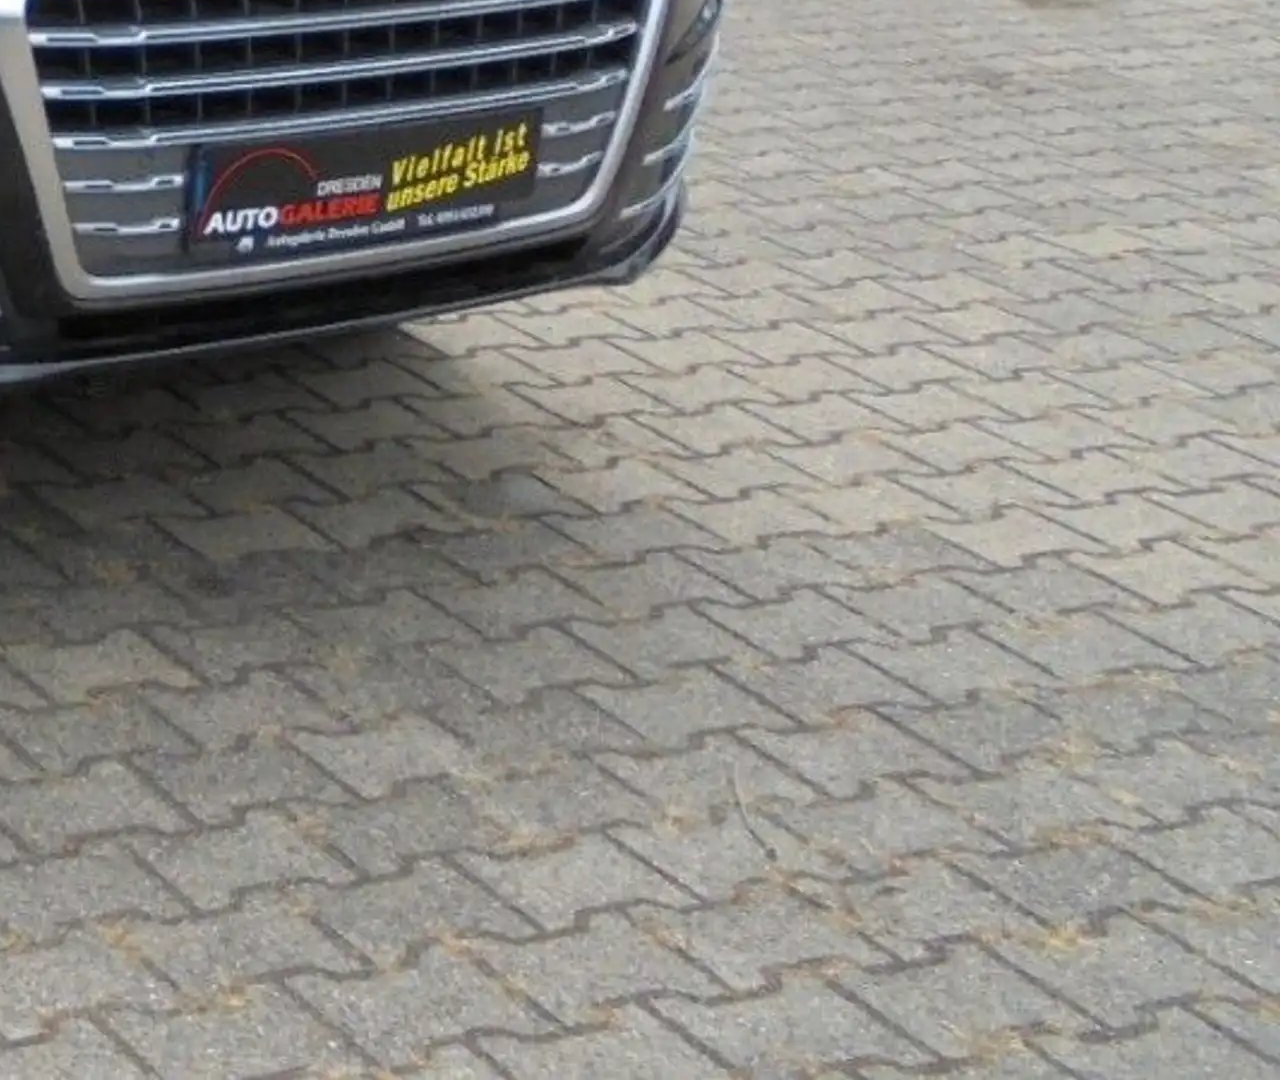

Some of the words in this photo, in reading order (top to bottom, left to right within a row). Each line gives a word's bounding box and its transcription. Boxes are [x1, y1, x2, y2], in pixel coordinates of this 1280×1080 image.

[391, 134, 488, 186] Vielfalt
[317, 174, 384, 197] DRESDEN
[386, 172, 460, 212] unsere
[203, 193, 383, 236] AUTOGALERIE
